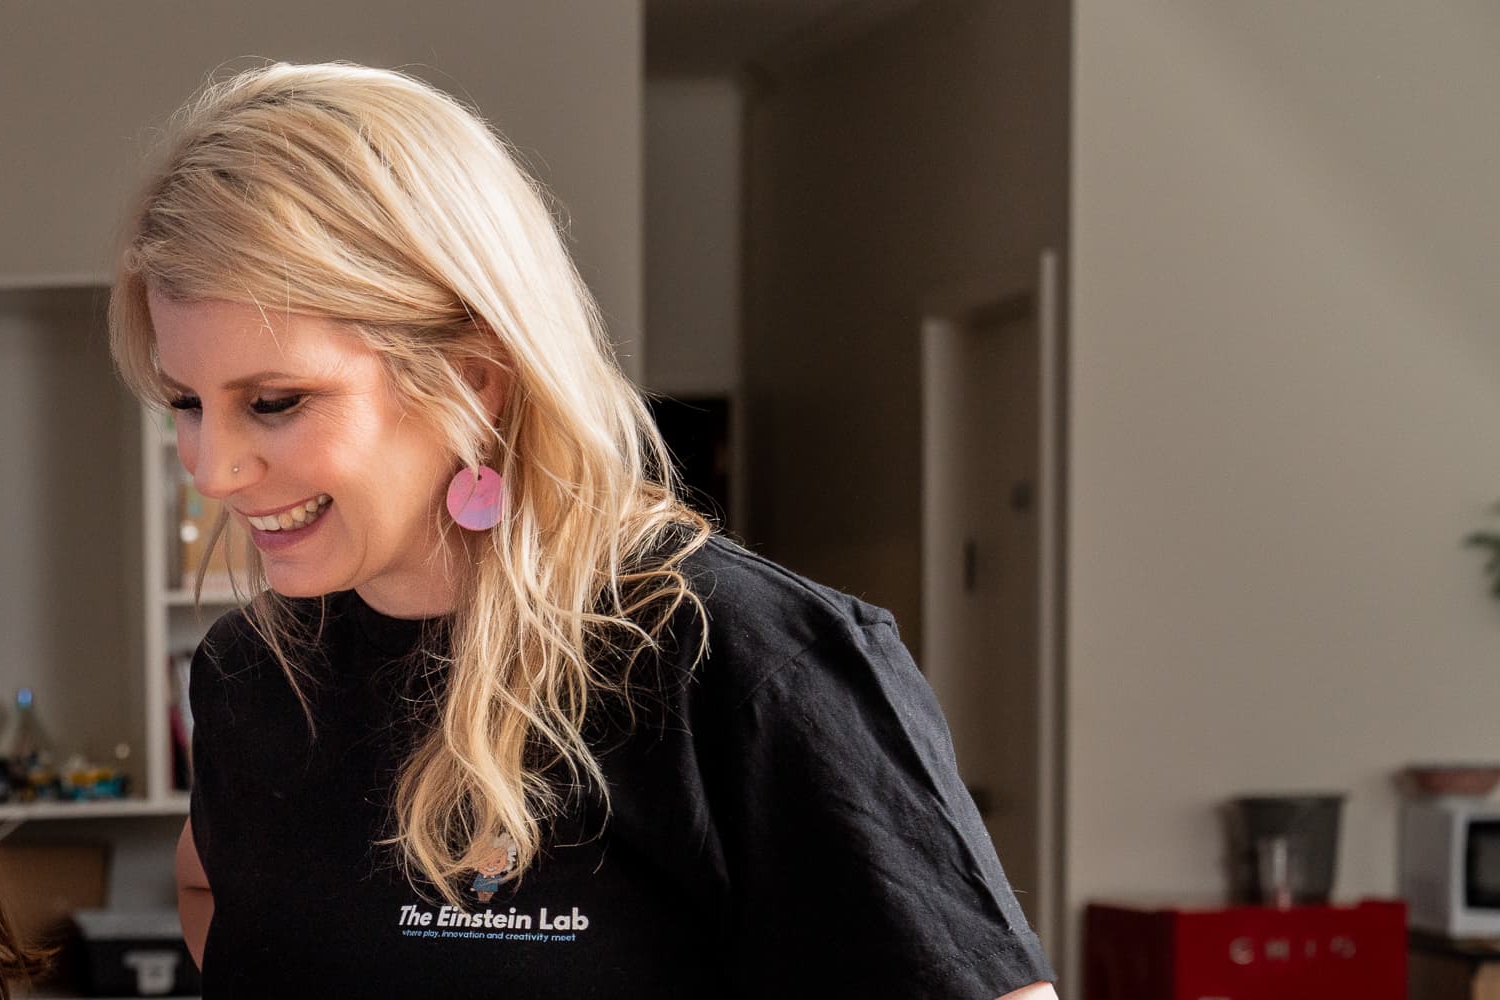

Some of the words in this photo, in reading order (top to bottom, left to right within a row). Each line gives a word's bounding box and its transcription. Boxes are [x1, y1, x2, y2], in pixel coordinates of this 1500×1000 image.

[399, 904, 433, 926] The
[437, 905, 532, 930] Einstein
[540, 907, 589, 931] Lab
[402, 929, 422, 938] where
[441, 930, 485, 939] innovation
[486, 932, 504, 940] and
[505, 932, 549, 943] creativity
[551, 933, 576, 942] meet
